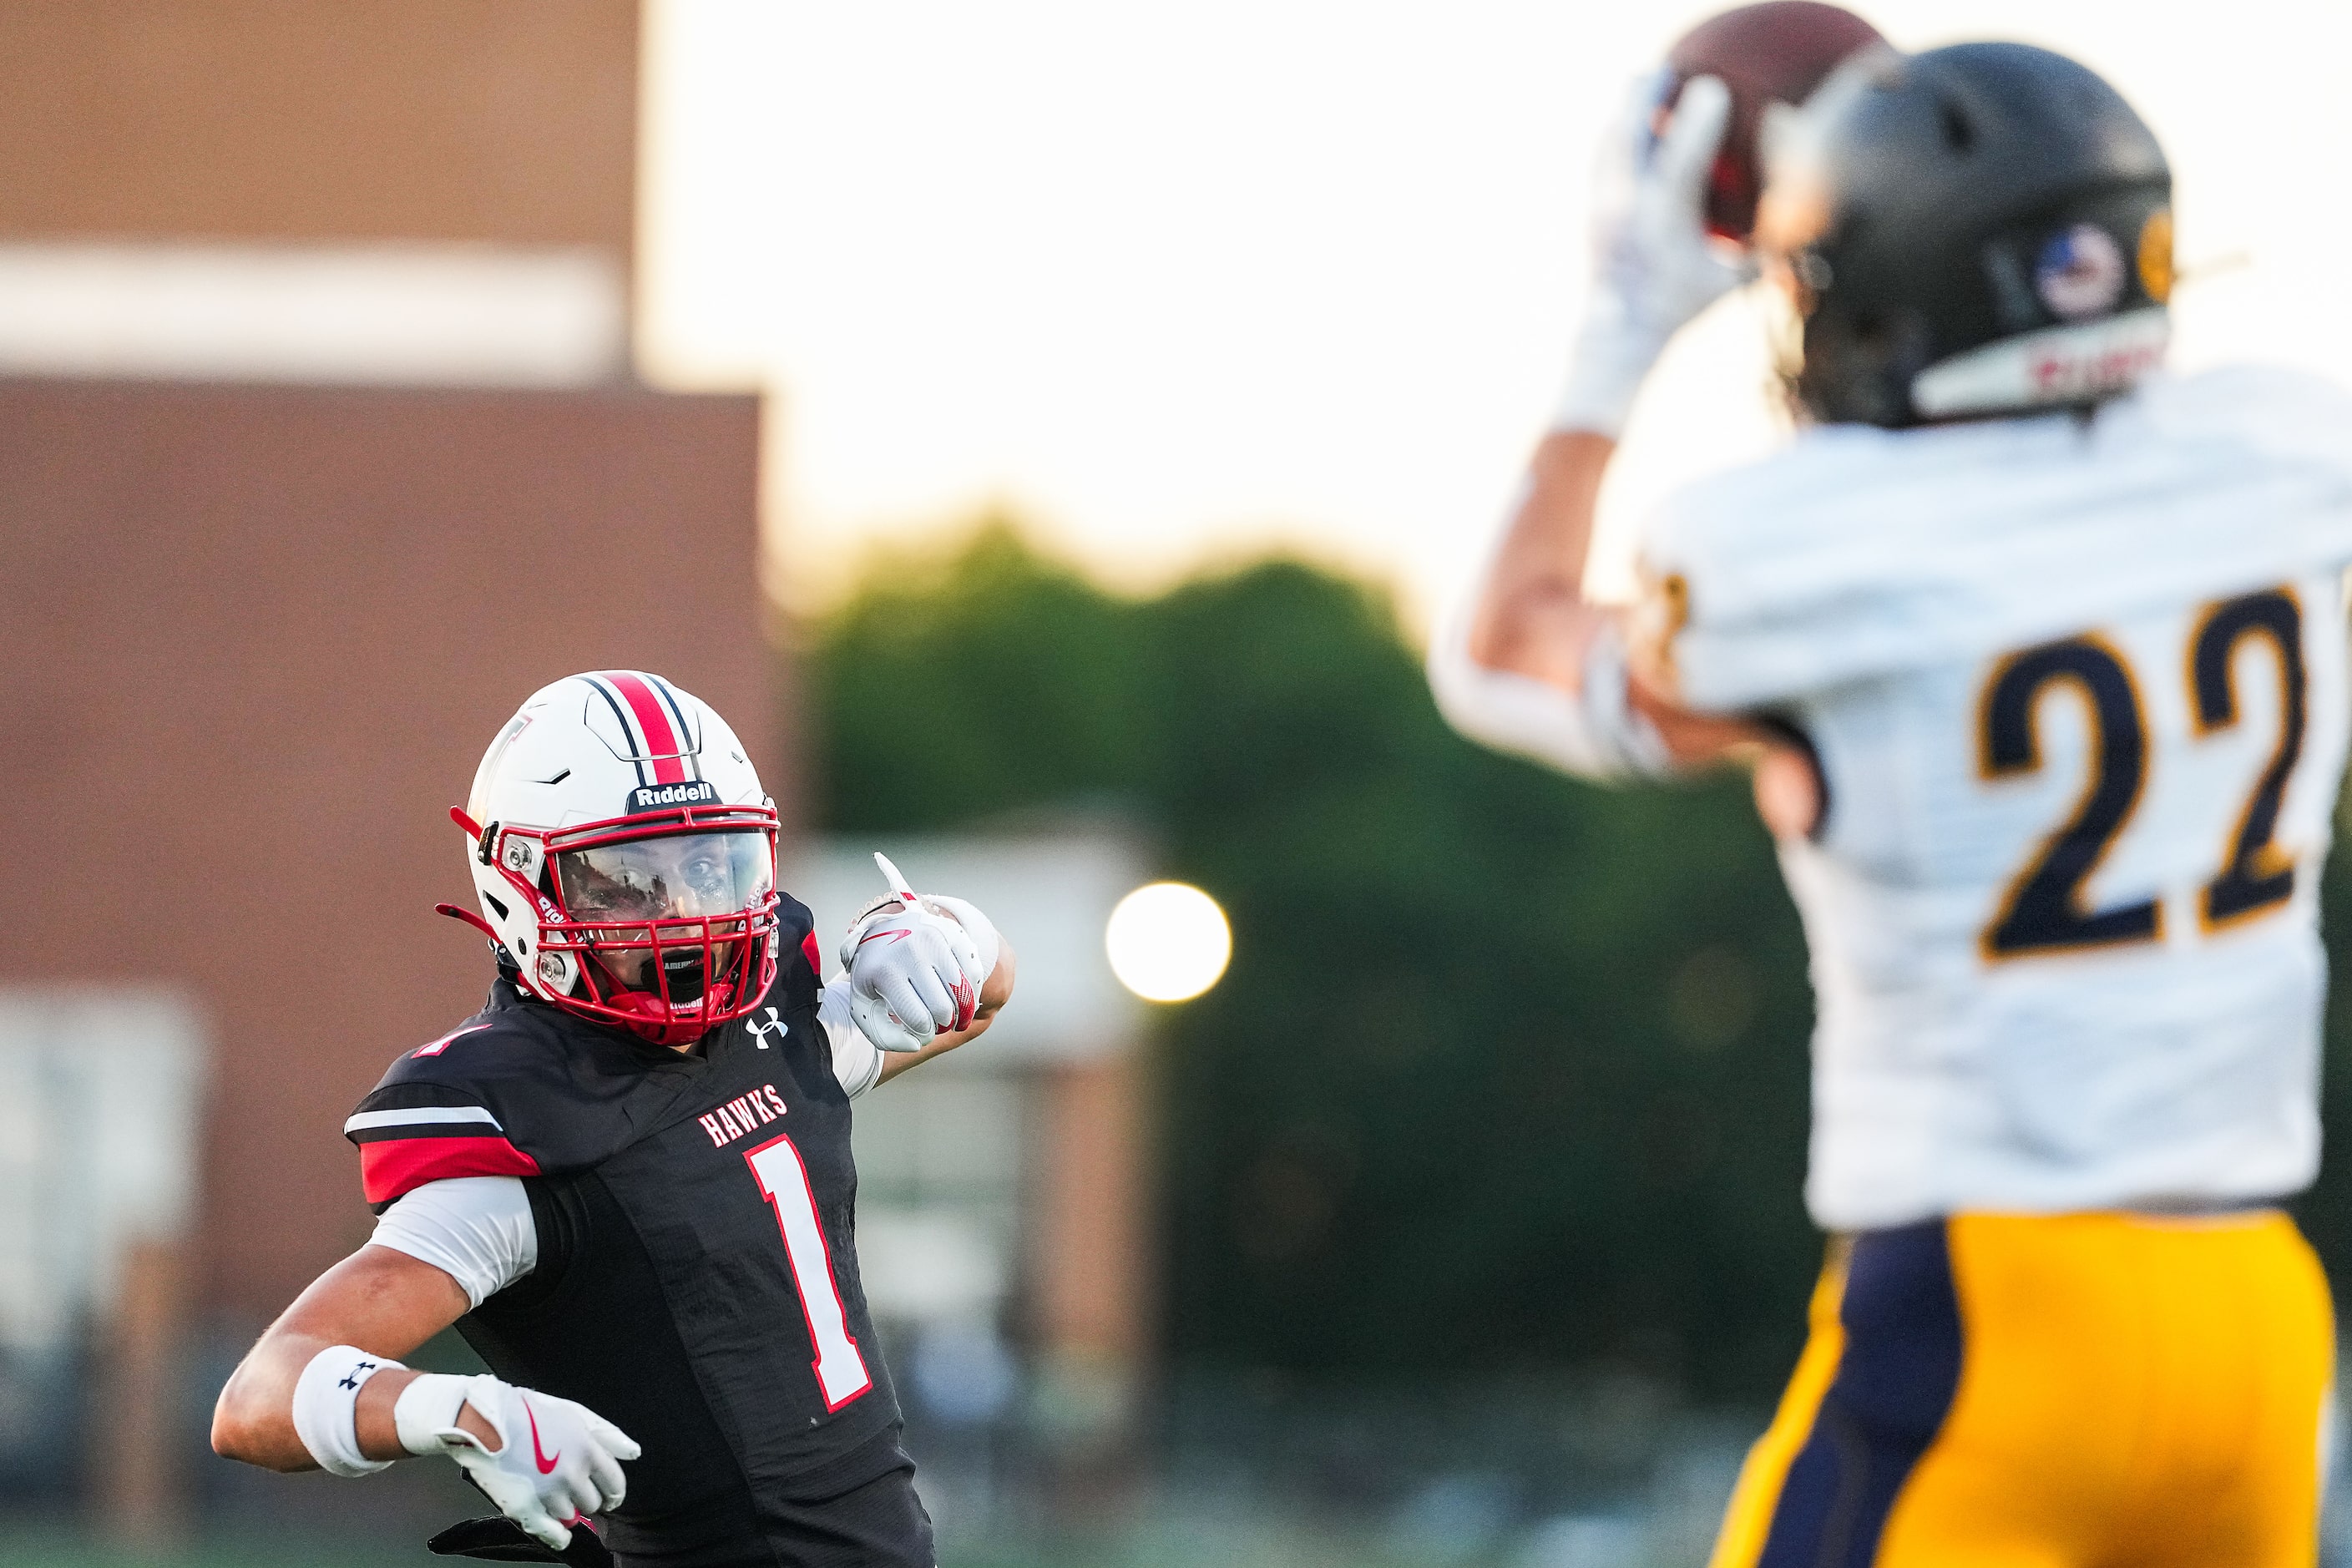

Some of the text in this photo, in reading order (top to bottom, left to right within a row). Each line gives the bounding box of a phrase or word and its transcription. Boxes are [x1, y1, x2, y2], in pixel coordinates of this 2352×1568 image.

[636, 783, 712, 807] Riddell
[1977, 584, 2306, 964] 22
[697, 1084, 788, 1149] HAWKS
[742, 1133, 873, 1414] 1
